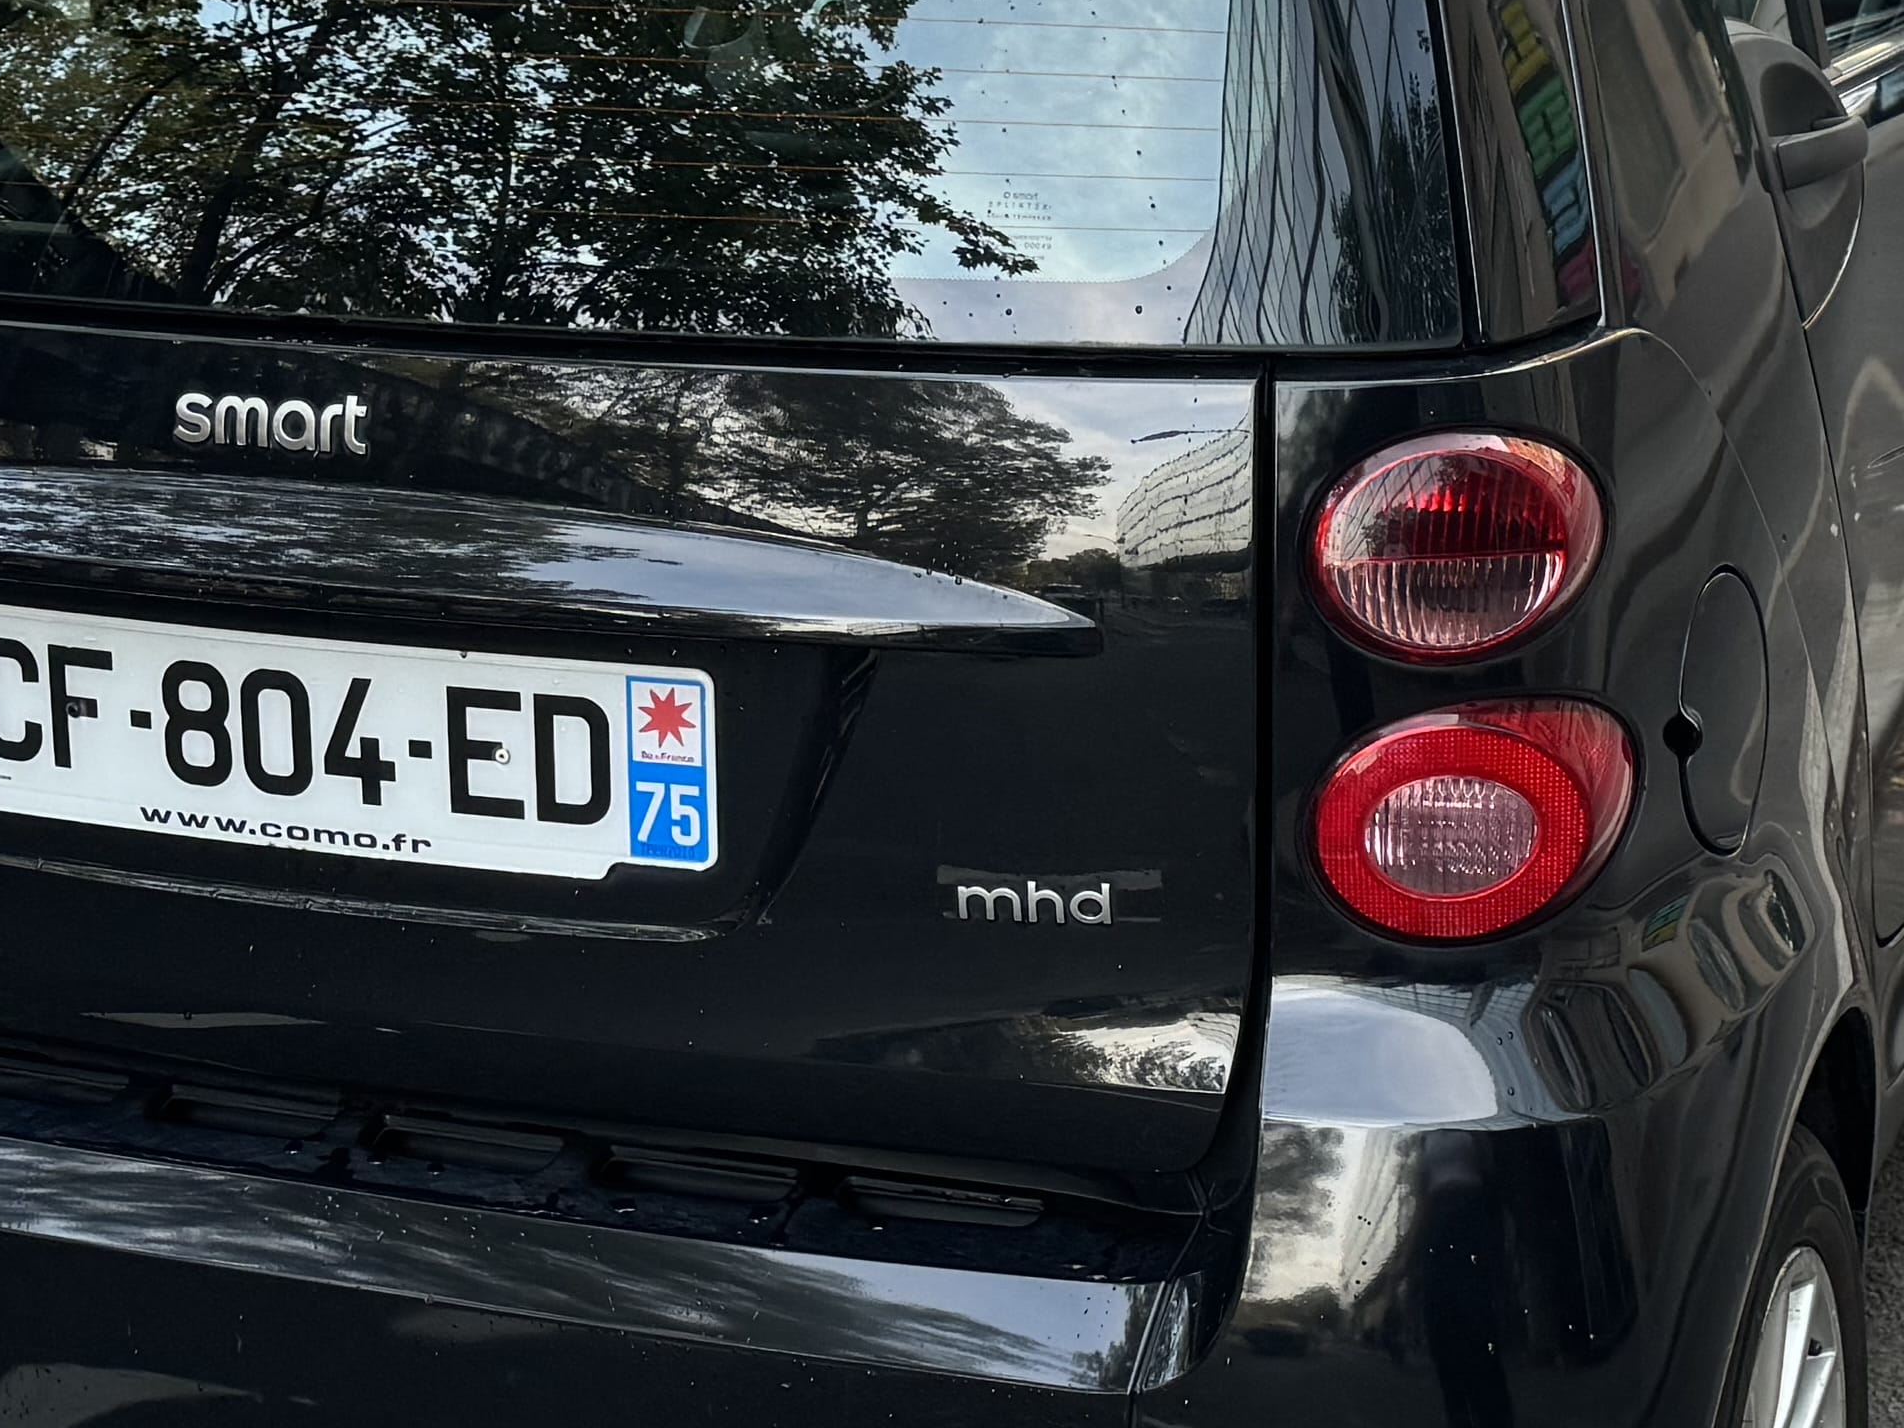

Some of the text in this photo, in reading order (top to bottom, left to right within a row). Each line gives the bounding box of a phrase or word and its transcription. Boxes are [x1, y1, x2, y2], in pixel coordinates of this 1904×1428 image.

[173, 392, 368, 455] smart
[140, 805, 433, 854] www.como.fr
[635, 780, 701, 847] 75
[957, 881, 1112, 924] mhd
